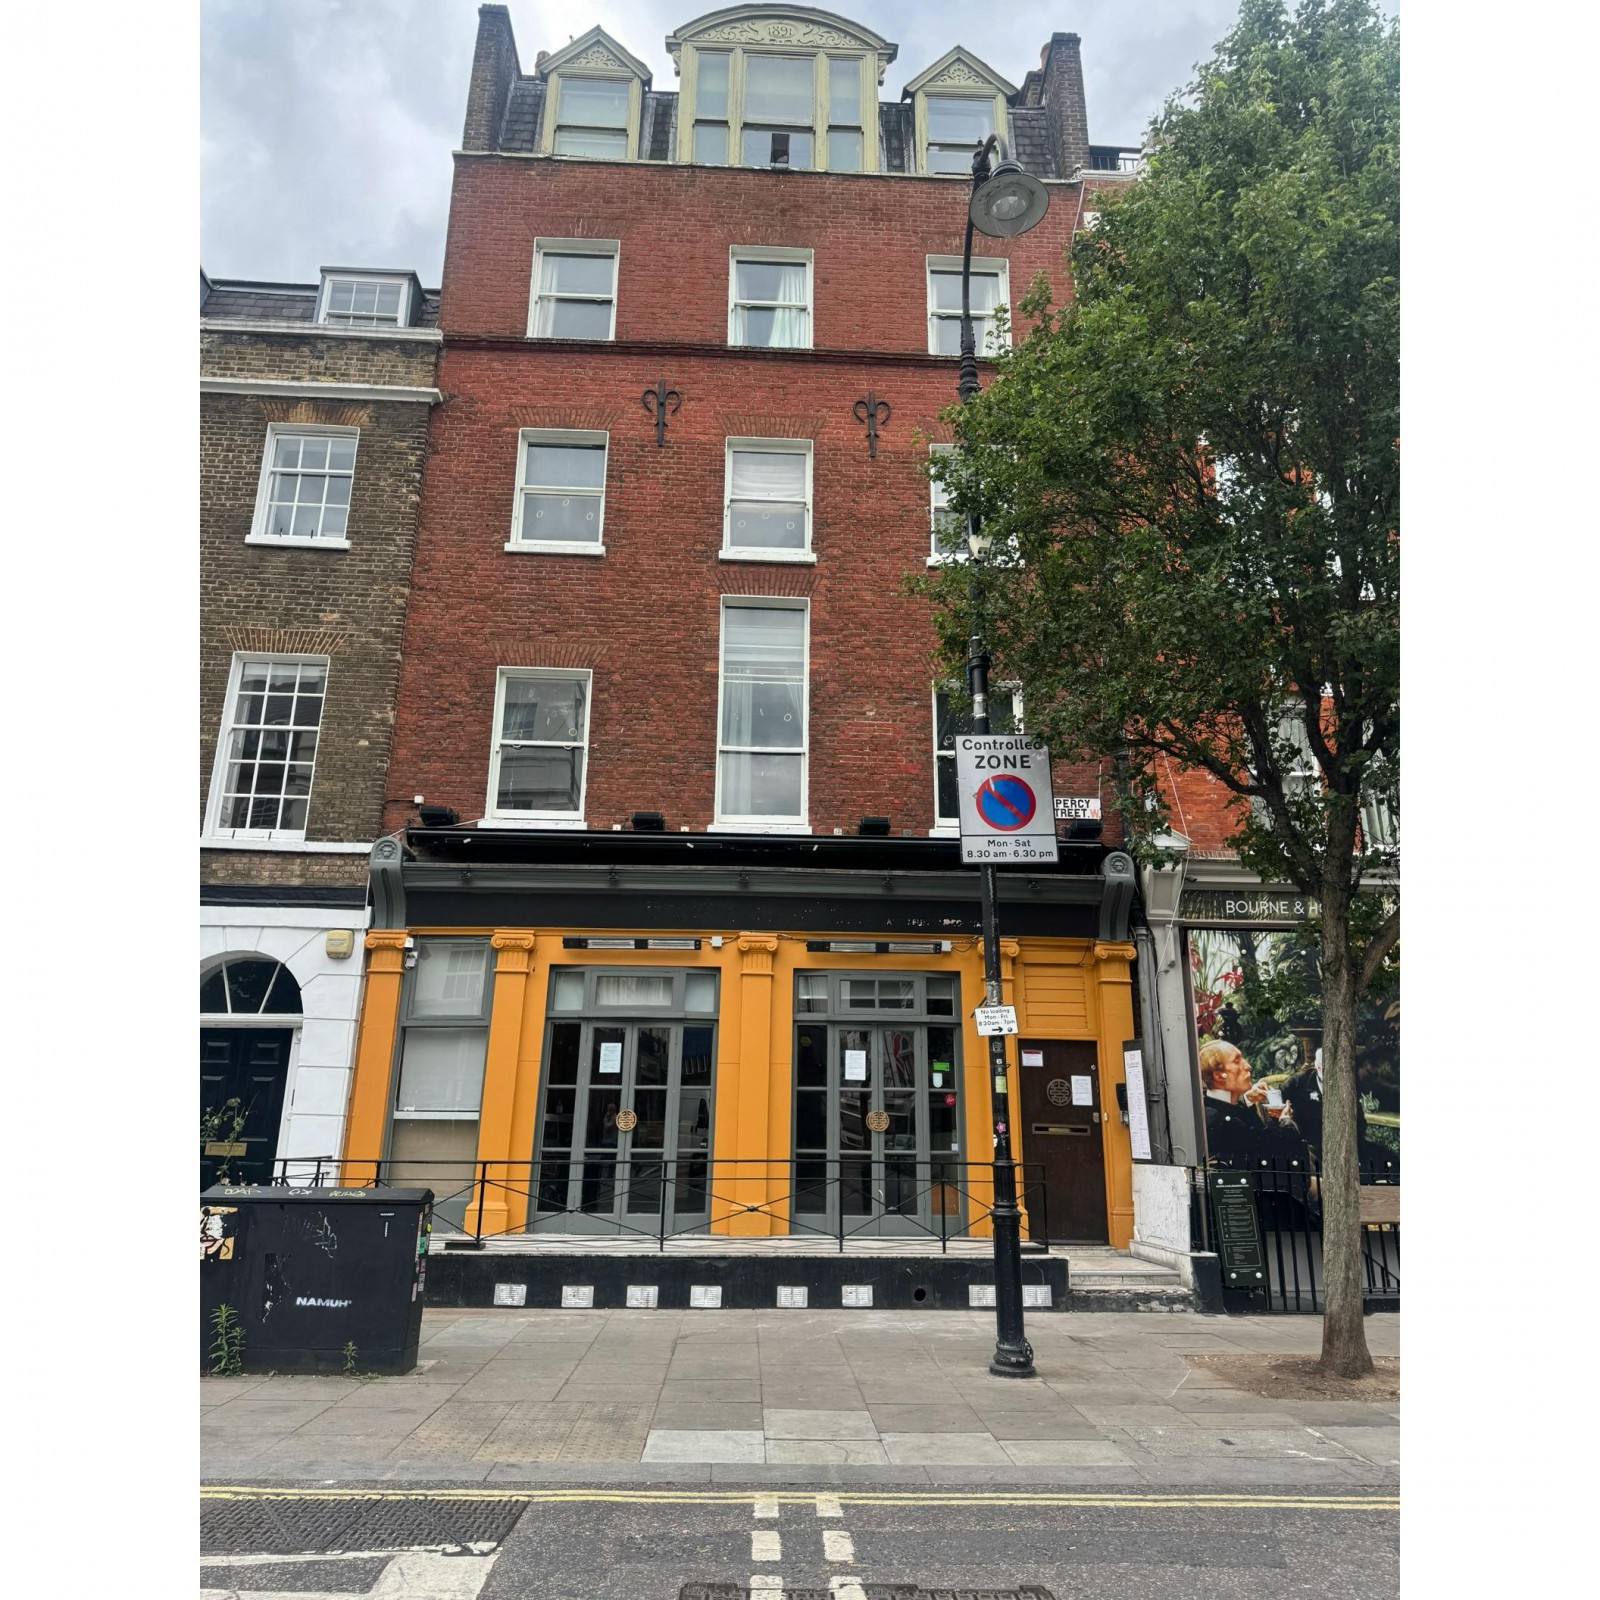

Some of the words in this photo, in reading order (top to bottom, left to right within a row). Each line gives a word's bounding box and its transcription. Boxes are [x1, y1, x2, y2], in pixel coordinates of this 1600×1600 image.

[768, 26, 792, 36] 1891
[974, 754, 1031, 769] ZONE
[1055, 799, 1091, 808] PERCY
[1055, 808, 1090, 818] TREET.
[987, 839, 1008, 848] Mon
[1014, 838, 1031, 848] Sat
[967, 849, 990, 858] 8.30
[1013, 849, 1036, 858] 6.30
[1039, 850, 1054, 858] pm
[1226, 901, 1289, 914] BOURNE
[1294, 901, 1305, 914] &
[296, 1296, 348, 1307] NAMUH
